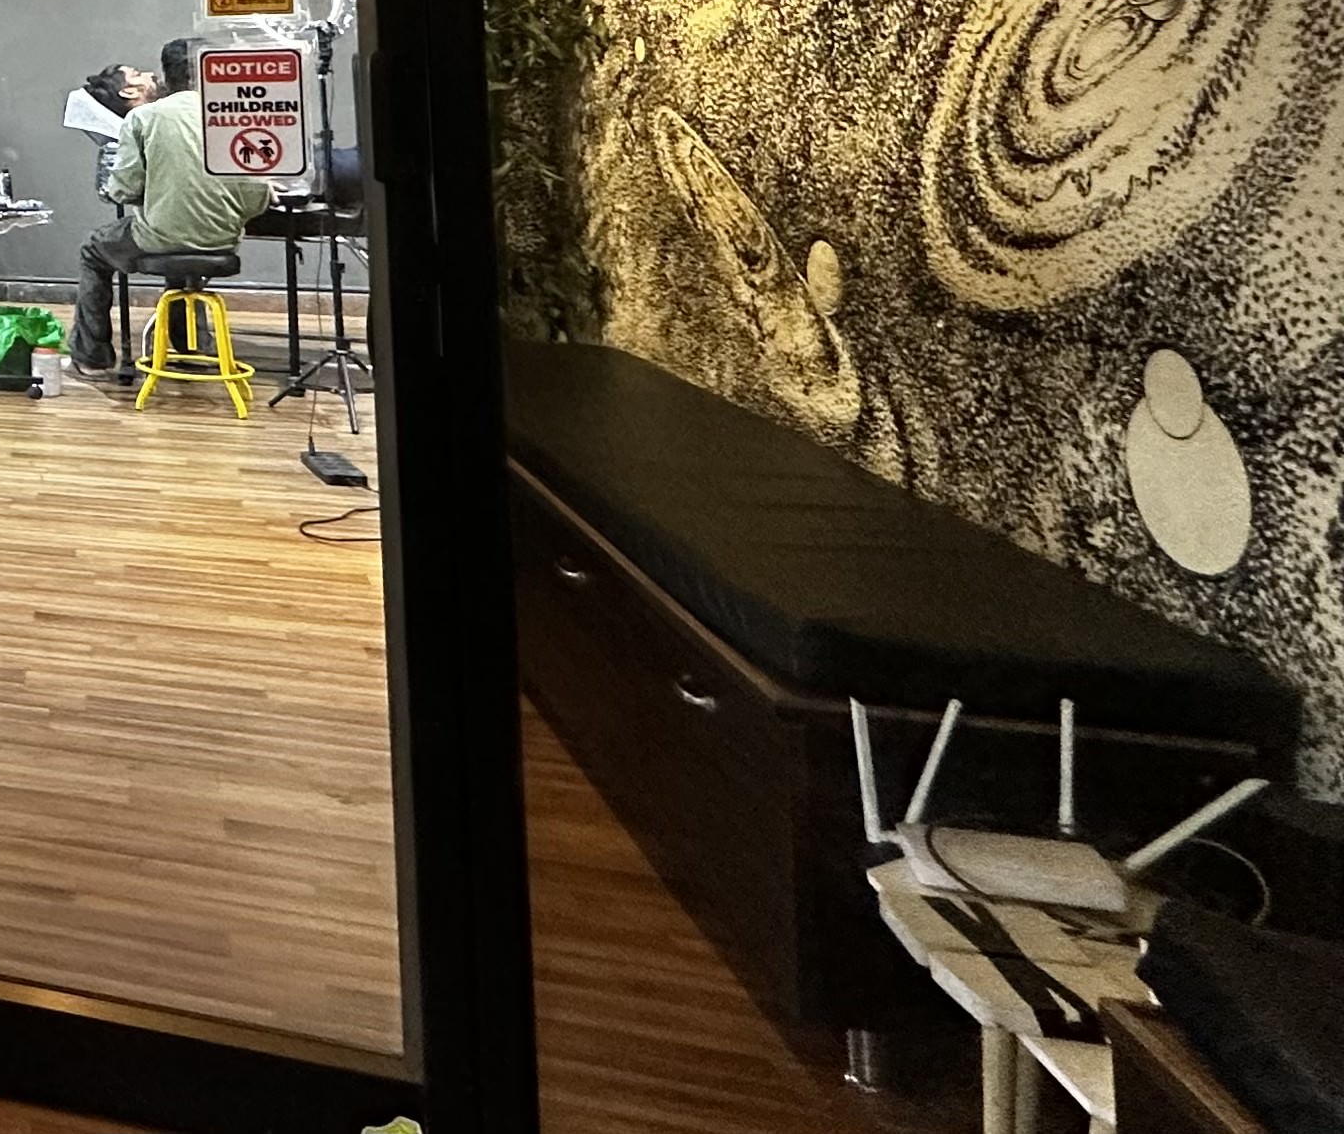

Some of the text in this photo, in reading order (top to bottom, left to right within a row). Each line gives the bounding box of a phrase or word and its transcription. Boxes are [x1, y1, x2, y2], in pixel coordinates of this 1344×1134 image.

[210, 61, 292, 76] NOTICE
[237, 86, 267, 99] NO
[207, 101, 299, 113] CHILDREN
[208, 115, 297, 127] ALLOWED
